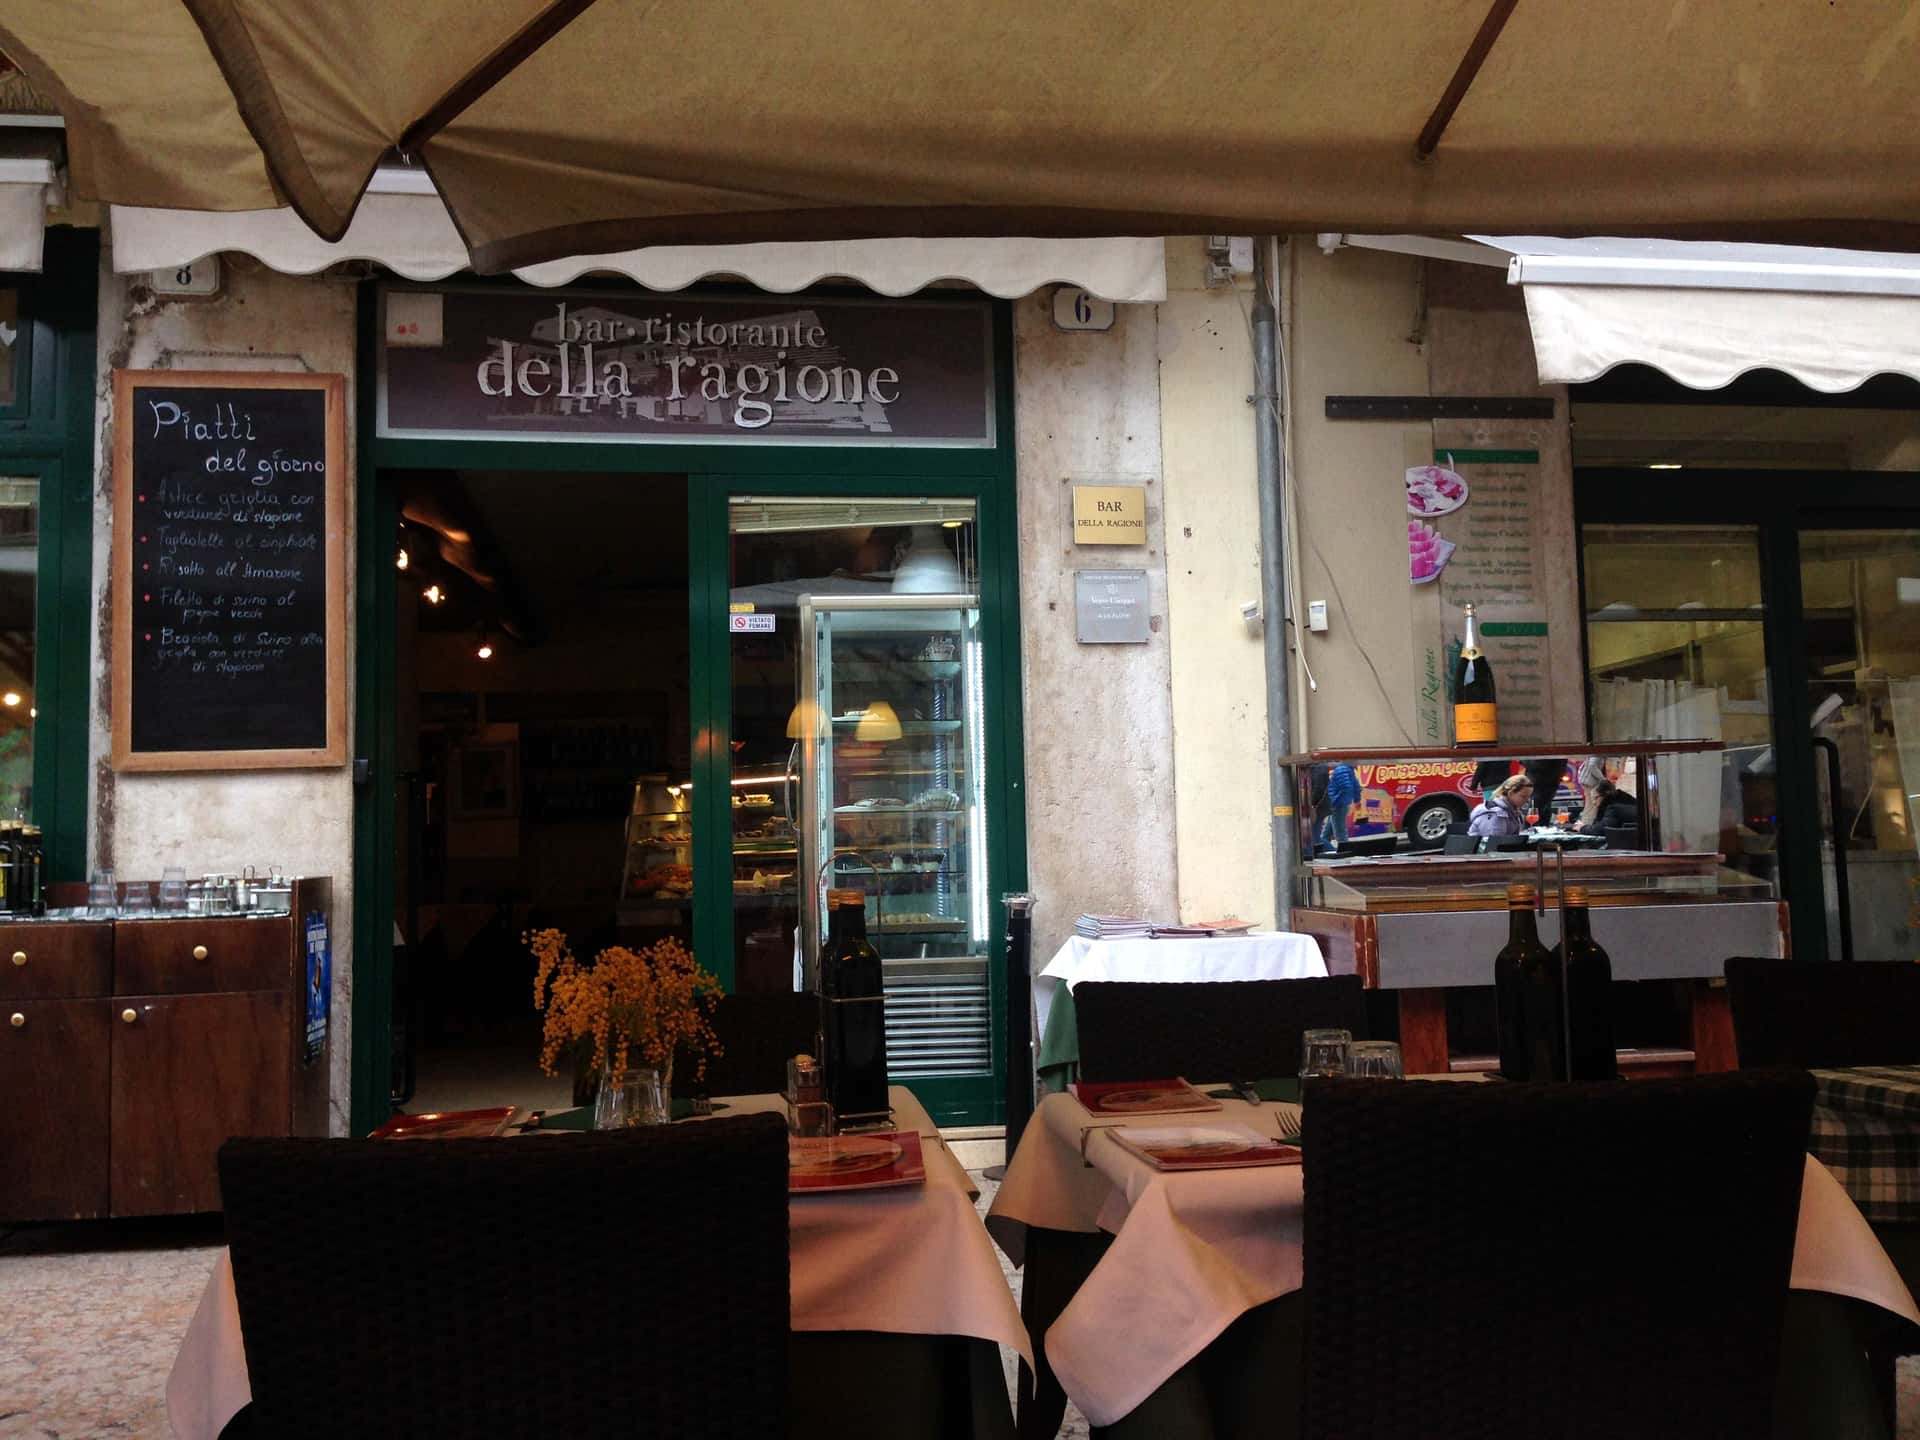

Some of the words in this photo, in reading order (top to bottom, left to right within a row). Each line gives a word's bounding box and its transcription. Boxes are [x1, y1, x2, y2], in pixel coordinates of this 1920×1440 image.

[1074, 292, 1091, 323] 6
[477, 340, 633, 401] della
[666, 350, 901, 429] ragione
[149, 400, 257, 440] Piatti
[205, 448, 247, 473] del
[251, 448, 326, 486] giorno
[232, 511, 249, 523] di
[253, 511, 304, 529] stagione
[1096, 501, 1123, 512] BAR
[1077, 519, 1104, 528] DELLA
[1106, 519, 1144, 529] RAGIONE
